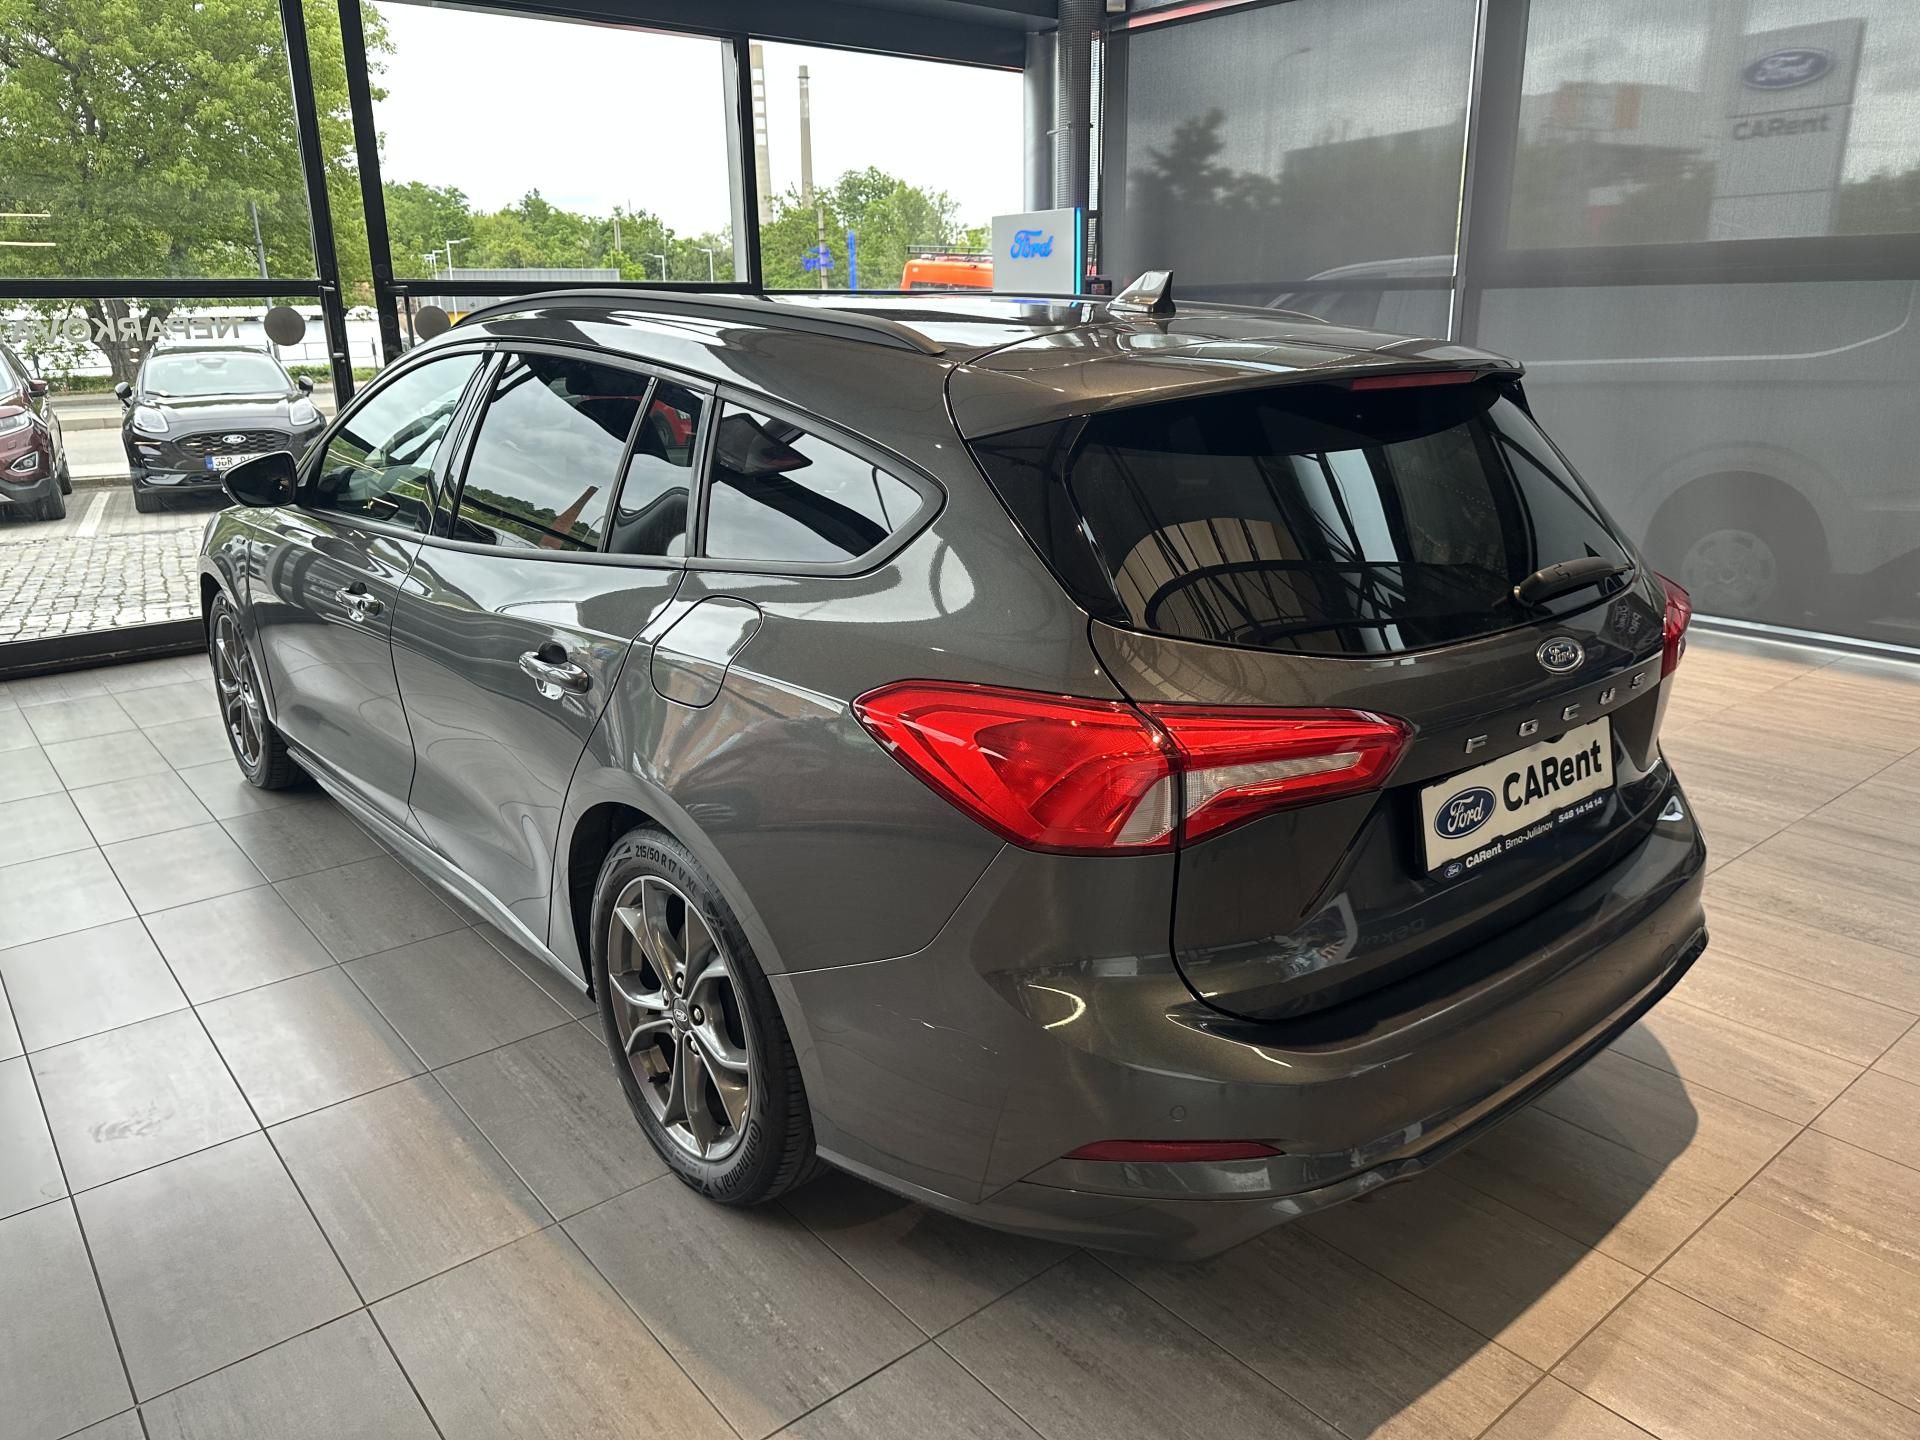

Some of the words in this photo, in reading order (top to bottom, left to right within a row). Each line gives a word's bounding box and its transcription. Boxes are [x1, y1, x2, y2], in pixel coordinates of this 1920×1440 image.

[1733, 114, 1831, 141] CARent
[1010, 230, 1054, 259] Ford
[1465, 672, 1645, 753] FOCUS
[1502, 739, 1602, 812] CARent
[1447, 795, 1484, 833] Ford
[1465, 843, 1502, 868] CARent
[1505, 821, 1554, 849] Brno-Juliánov
[1558, 809, 1575, 823] 548
[1575, 805, 1585, 815] 14
[1584, 801, 1594, 811] 14
[1593, 796, 1603, 807] 14
[635, 845, 660, 863] 215/50
[660, 853, 668, 869] R
[668, 859, 677, 873] 17
[678, 866, 686, 881] V
[720, 1118, 762, 1194] Continental
